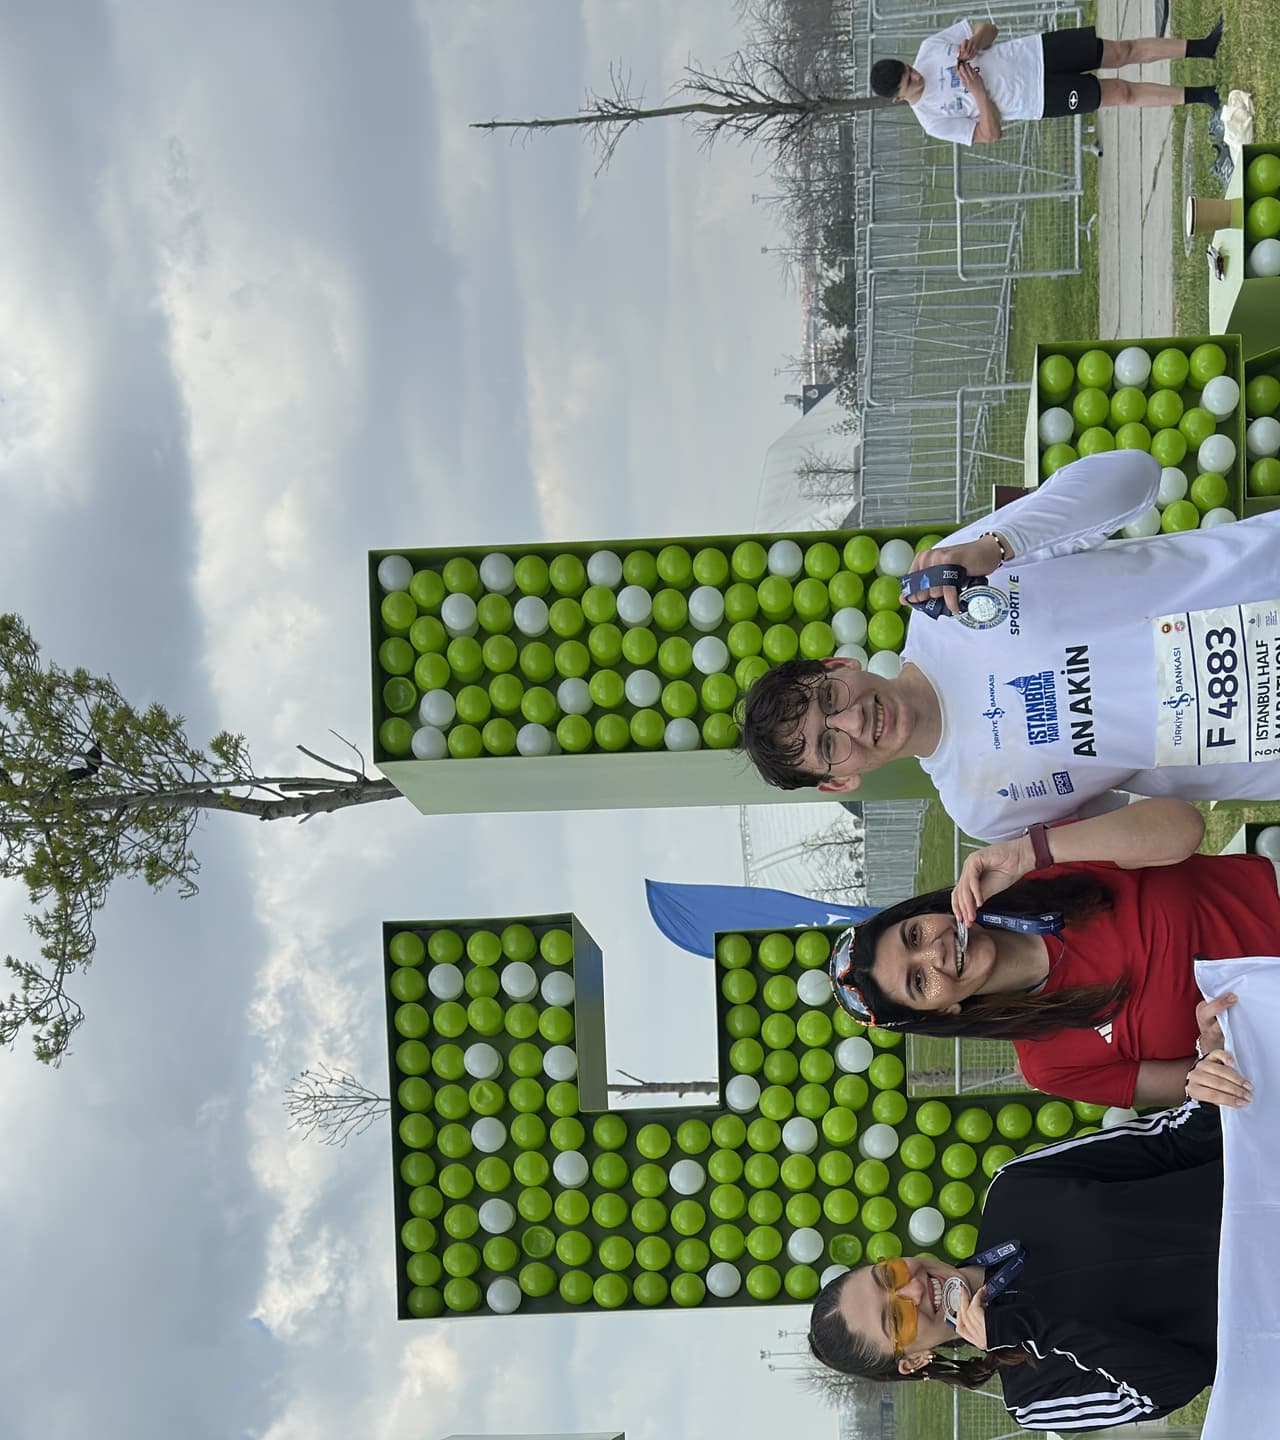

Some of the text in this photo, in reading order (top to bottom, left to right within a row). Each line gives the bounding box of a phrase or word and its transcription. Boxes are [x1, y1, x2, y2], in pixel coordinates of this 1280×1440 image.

[1009, 575, 1020, 635] SPORTIVE
[988, 674, 997, 708] BANKASI
[1174, 648, 1184, 692] BANKASI
[1206, 627, 1238, 719] 4883
[1256, 640, 1270, 740] ISTANBUL HALF
[992, 720, 1001, 750] TÜRKİYE
[1023, 673, 1047, 745] İSTANBUL
[1042, 671, 1060, 743] YARI MARATONU
[1174, 710, 1184, 746] TÜRKİYE
